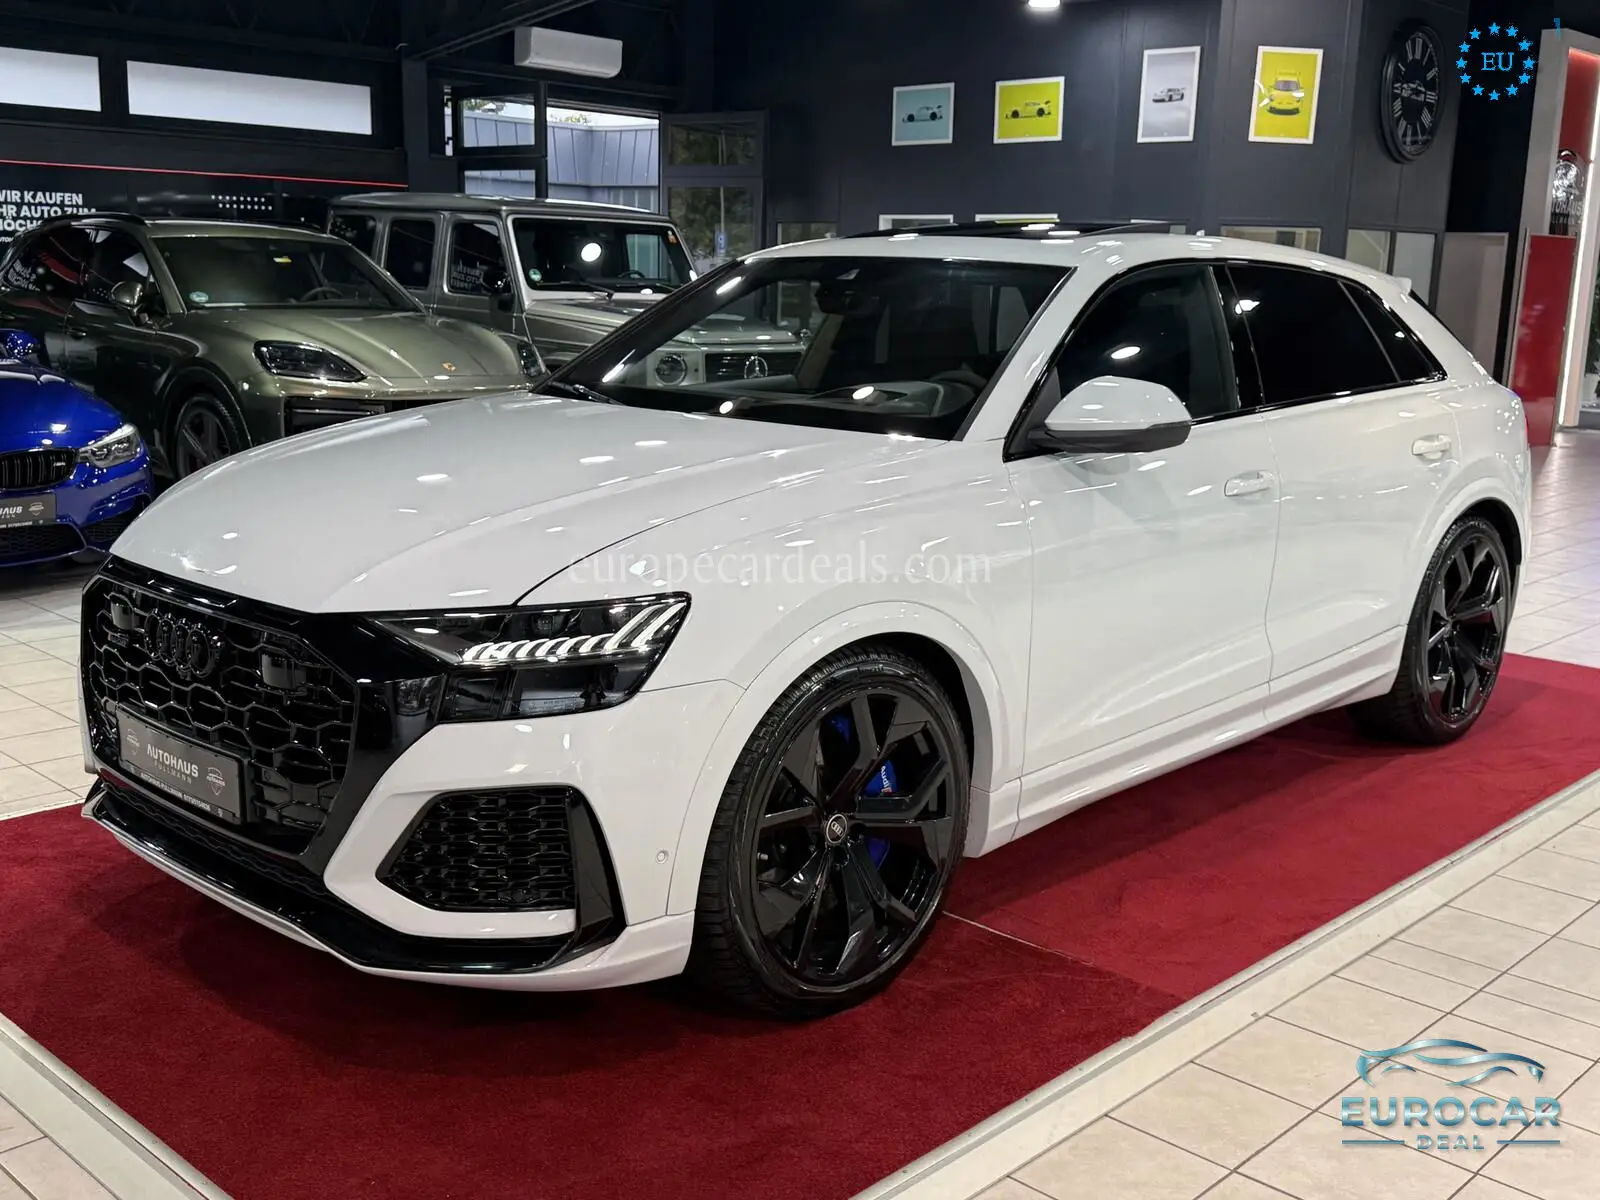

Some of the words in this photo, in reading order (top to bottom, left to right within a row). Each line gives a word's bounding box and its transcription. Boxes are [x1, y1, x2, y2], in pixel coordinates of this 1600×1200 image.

[24, 190, 83, 206] KAUFEN
[20, 205, 62, 218] AUTO
[147, 743, 199, 778] AUTOHAUS
